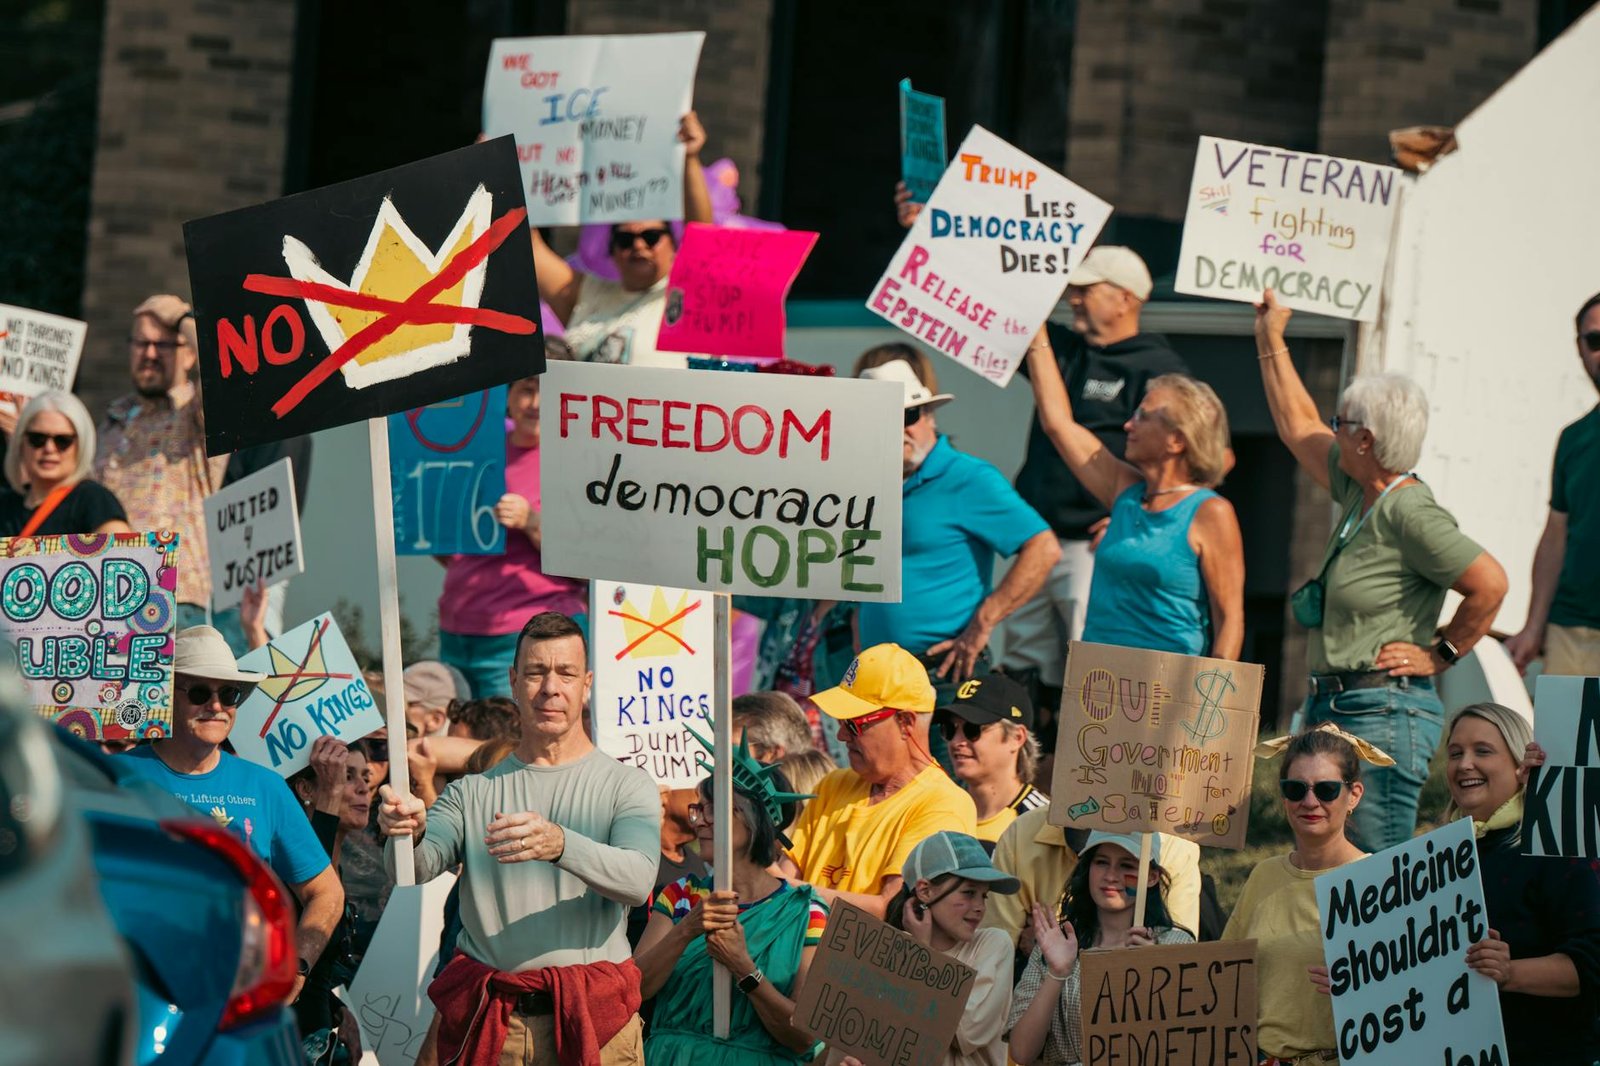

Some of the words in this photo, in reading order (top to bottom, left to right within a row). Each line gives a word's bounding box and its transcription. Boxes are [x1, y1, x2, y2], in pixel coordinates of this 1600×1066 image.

[521, 72, 560, 88] GOT
[538, 86, 611, 126] ICE
[517, 143, 544, 162] UT
[960, 153, 1038, 190] TRUMP
[1215, 143, 1394, 206] VETERAN
[1025, 193, 1076, 219] LIES
[1199, 184, 1232, 200] Still
[931, 208, 1084, 244] DEMOCRACY
[1250, 197, 1356, 249] Fighting
[1000, 244, 1070, 274] DIES!
[899, 245, 997, 332] RELEASE
[1003, 318, 1031, 336] the
[1195, 255, 1372, 318] DEMOCRACY
[216, 304, 306, 379] NO
[872, 277, 968, 357] EPSTEIN
[972, 345, 1008, 371] files
[560, 392, 831, 461] FREEDOM
[217, 487, 279, 532] UNITED
[407, 459, 501, 553] 1776
[585, 453, 875, 558] democracy
[244, 526, 253, 550] 4
[696, 524, 884, 594] HOPE
[0, 557, 150, 622] OOD
[223, 541, 294, 591] JUSTICE
[18, 632, 169, 682] UBLE
[637, 666, 674, 692] NO
[265, 718, 307, 767] NO
[305, 679, 373, 736] KINGS
[617, 693, 710, 726] KINGS
[625, 729, 694, 754] DUMP
[191, 793, 226, 805] Lifting
[227, 794, 257, 806] Others
[1077, 765, 1107, 784] IS
[1131, 768, 1185, 795] NOT
[1202, 775, 1232, 803] for
[1326, 839, 1475, 940] Medicine
[828, 907, 972, 998] EVERYBODY
[1330, 894, 1484, 997] shouldn't
[1091, 958, 1254, 1024] ARREST
[1340, 987, 1426, 1060] cost
[1447, 972, 1470, 1015] a
[809, 982, 919, 1066] HOME
